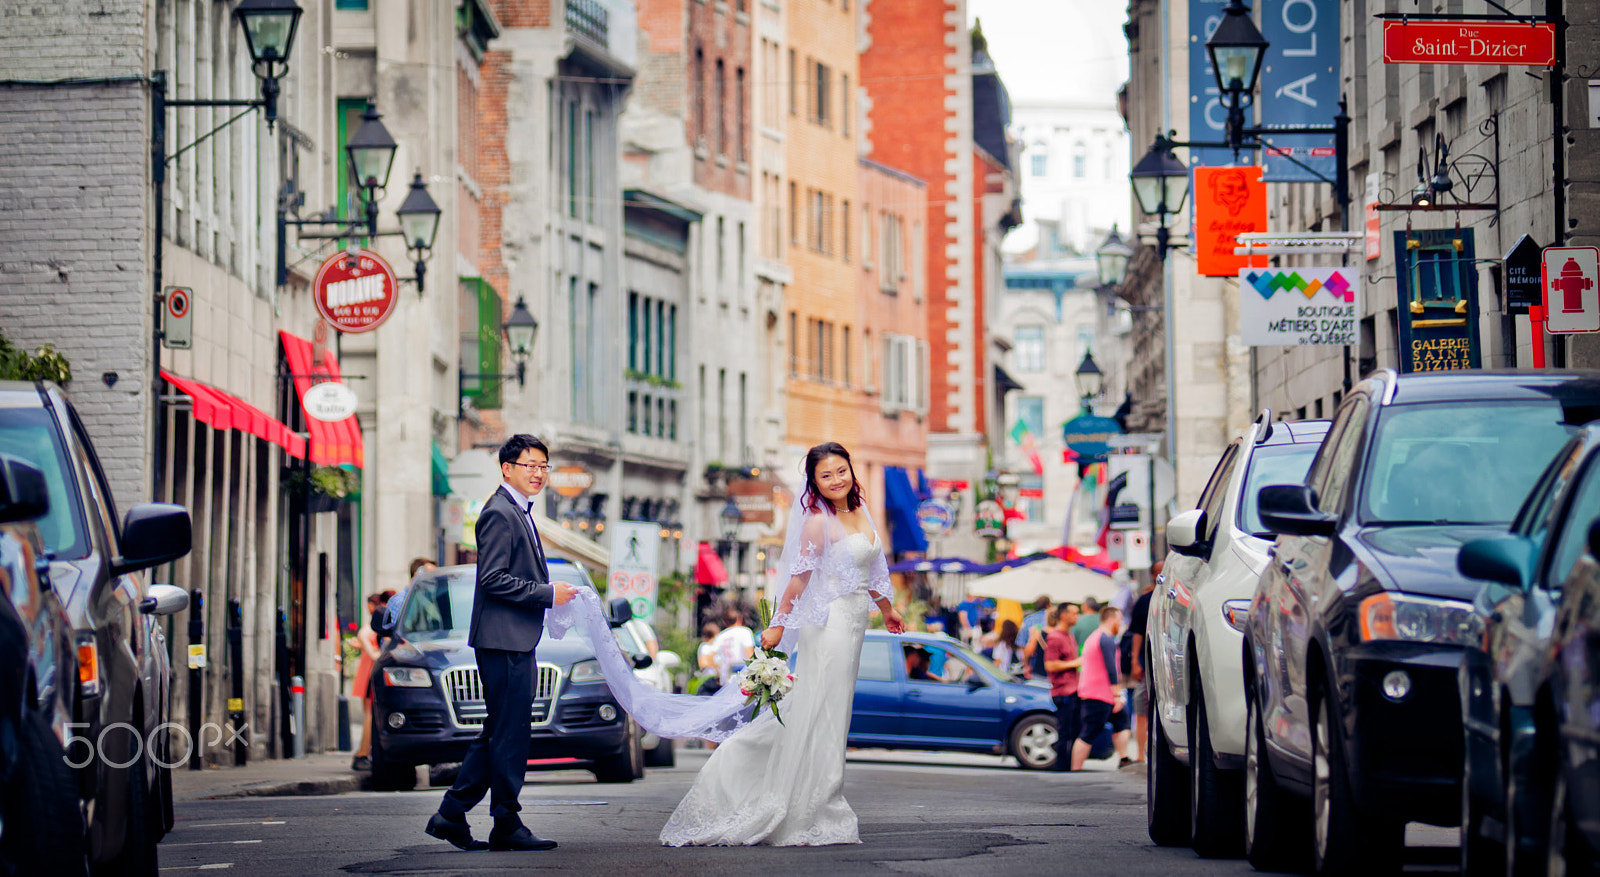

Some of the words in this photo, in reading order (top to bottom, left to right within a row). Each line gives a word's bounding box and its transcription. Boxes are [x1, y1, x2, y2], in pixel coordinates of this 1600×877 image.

[1459, 27, 1479, 38] Rue
[1412, 37, 1527, 57] Saint-Dizier
[1274, 72, 1318, 108] À
[1508, 265, 1527, 276] CITÉ
[1297, 306, 1355, 318] BOUTIQUE
[1268, 317, 1318, 332] MÉTIERS
[1320, 319, 1355, 332] D'ART
[1309, 331, 1355, 345] QUÉBEC
[1412, 338, 1470, 350] GALERIE
[1412, 348, 1470, 361] SAINT
[1412, 358, 1471, 372] DIZIER
